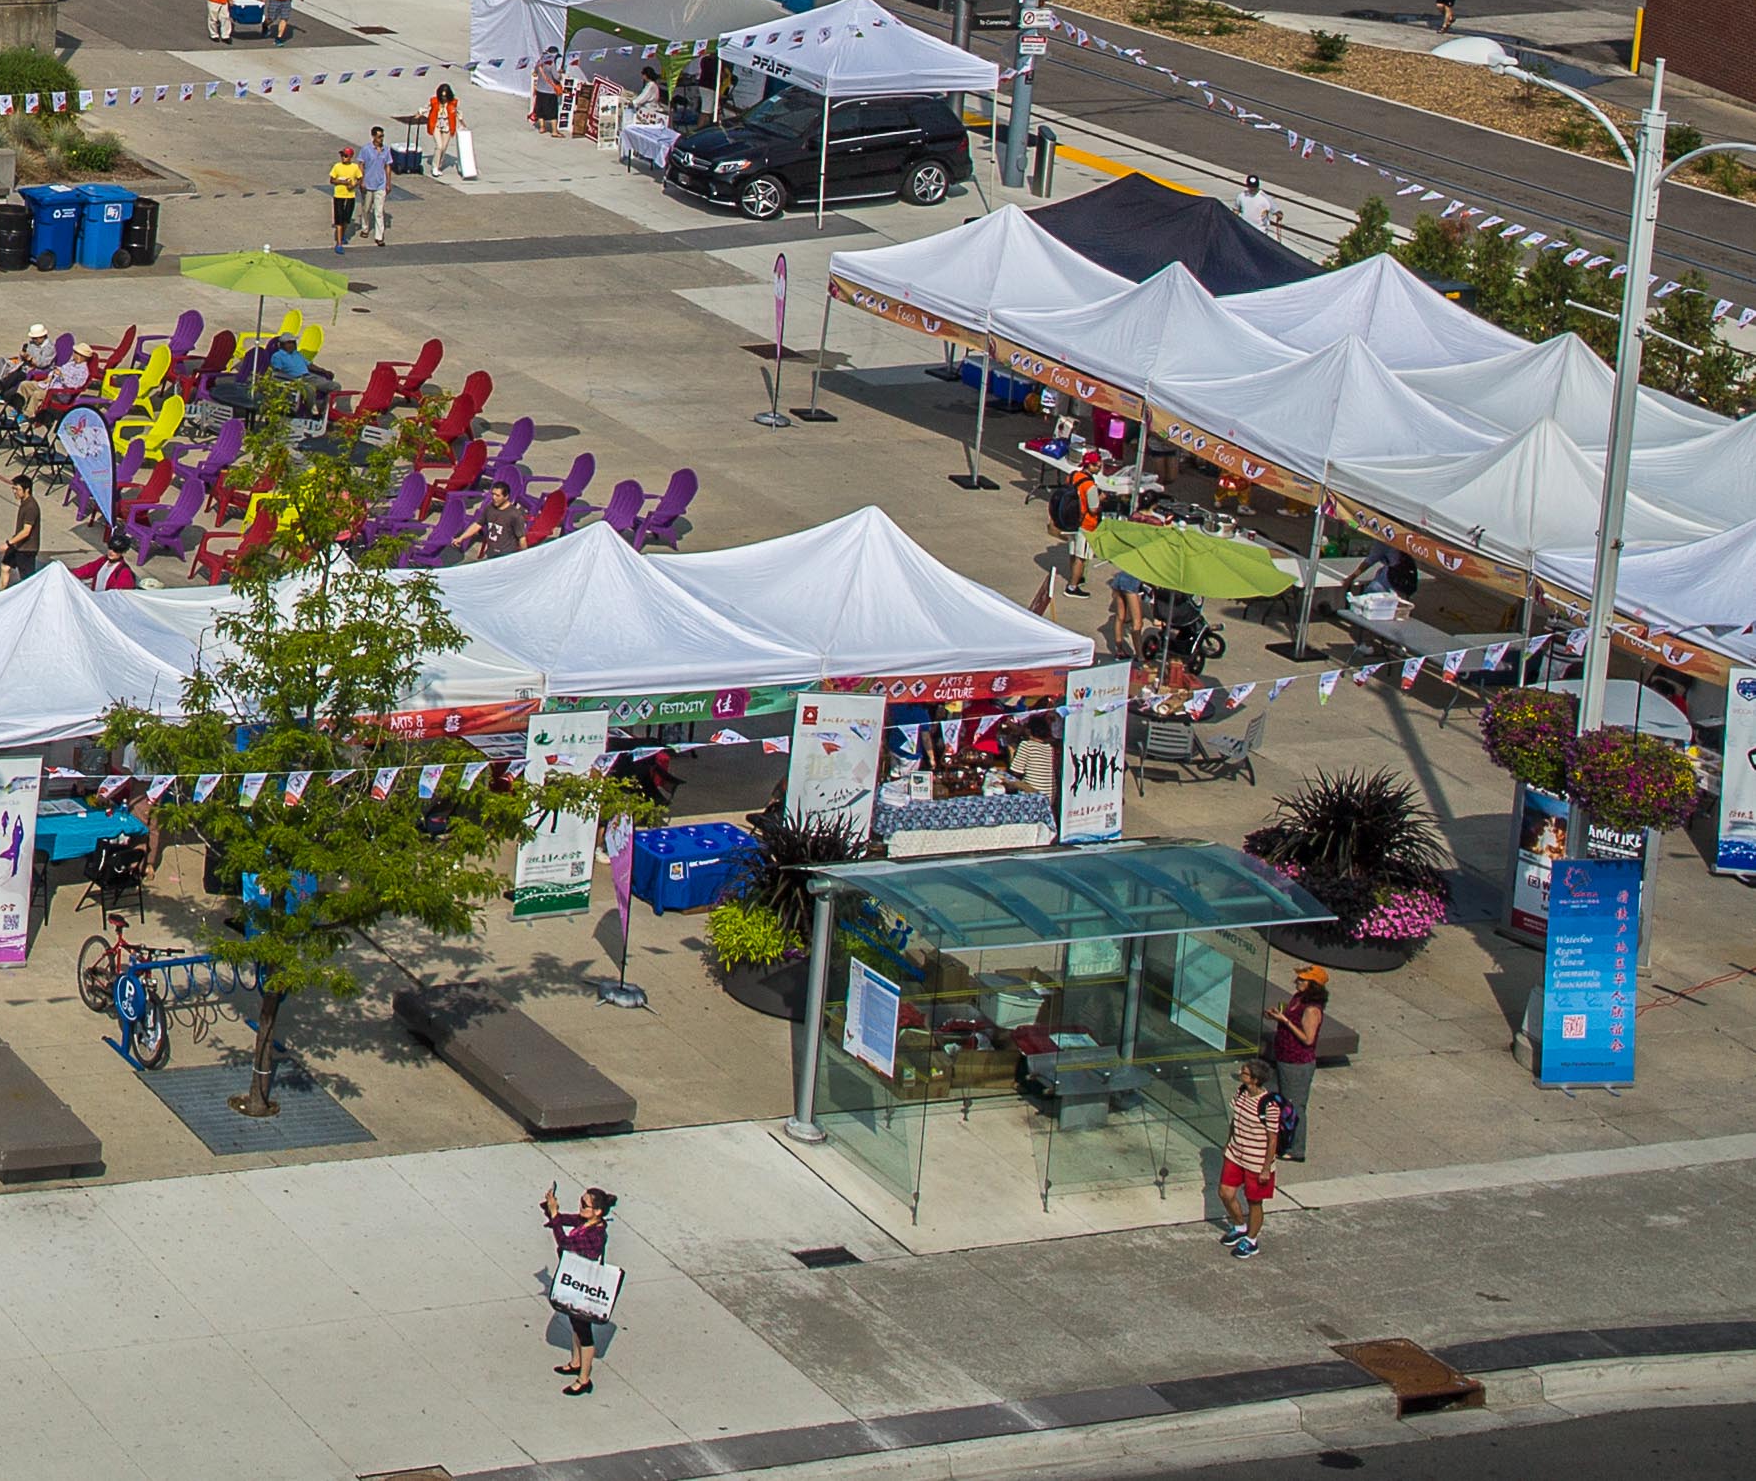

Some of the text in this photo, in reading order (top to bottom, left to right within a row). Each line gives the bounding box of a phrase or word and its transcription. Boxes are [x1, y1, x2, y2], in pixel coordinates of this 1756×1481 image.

[751, 54, 793, 78] PFAFF
[939, 677, 962, 687] ARTS
[933, 687, 975, 700] CULTURE
[659, 699, 706, 715] FESTIVITY
[390, 716, 413, 730] ARTS
[1556, 934, 1594, 944] Waterloo
[1555, 947, 1583, 958] Region
[1553, 958, 1585, 967] Chinese
[1553, 970, 1601, 981] Community
[560, 1272, 610, 1301] Bench.
